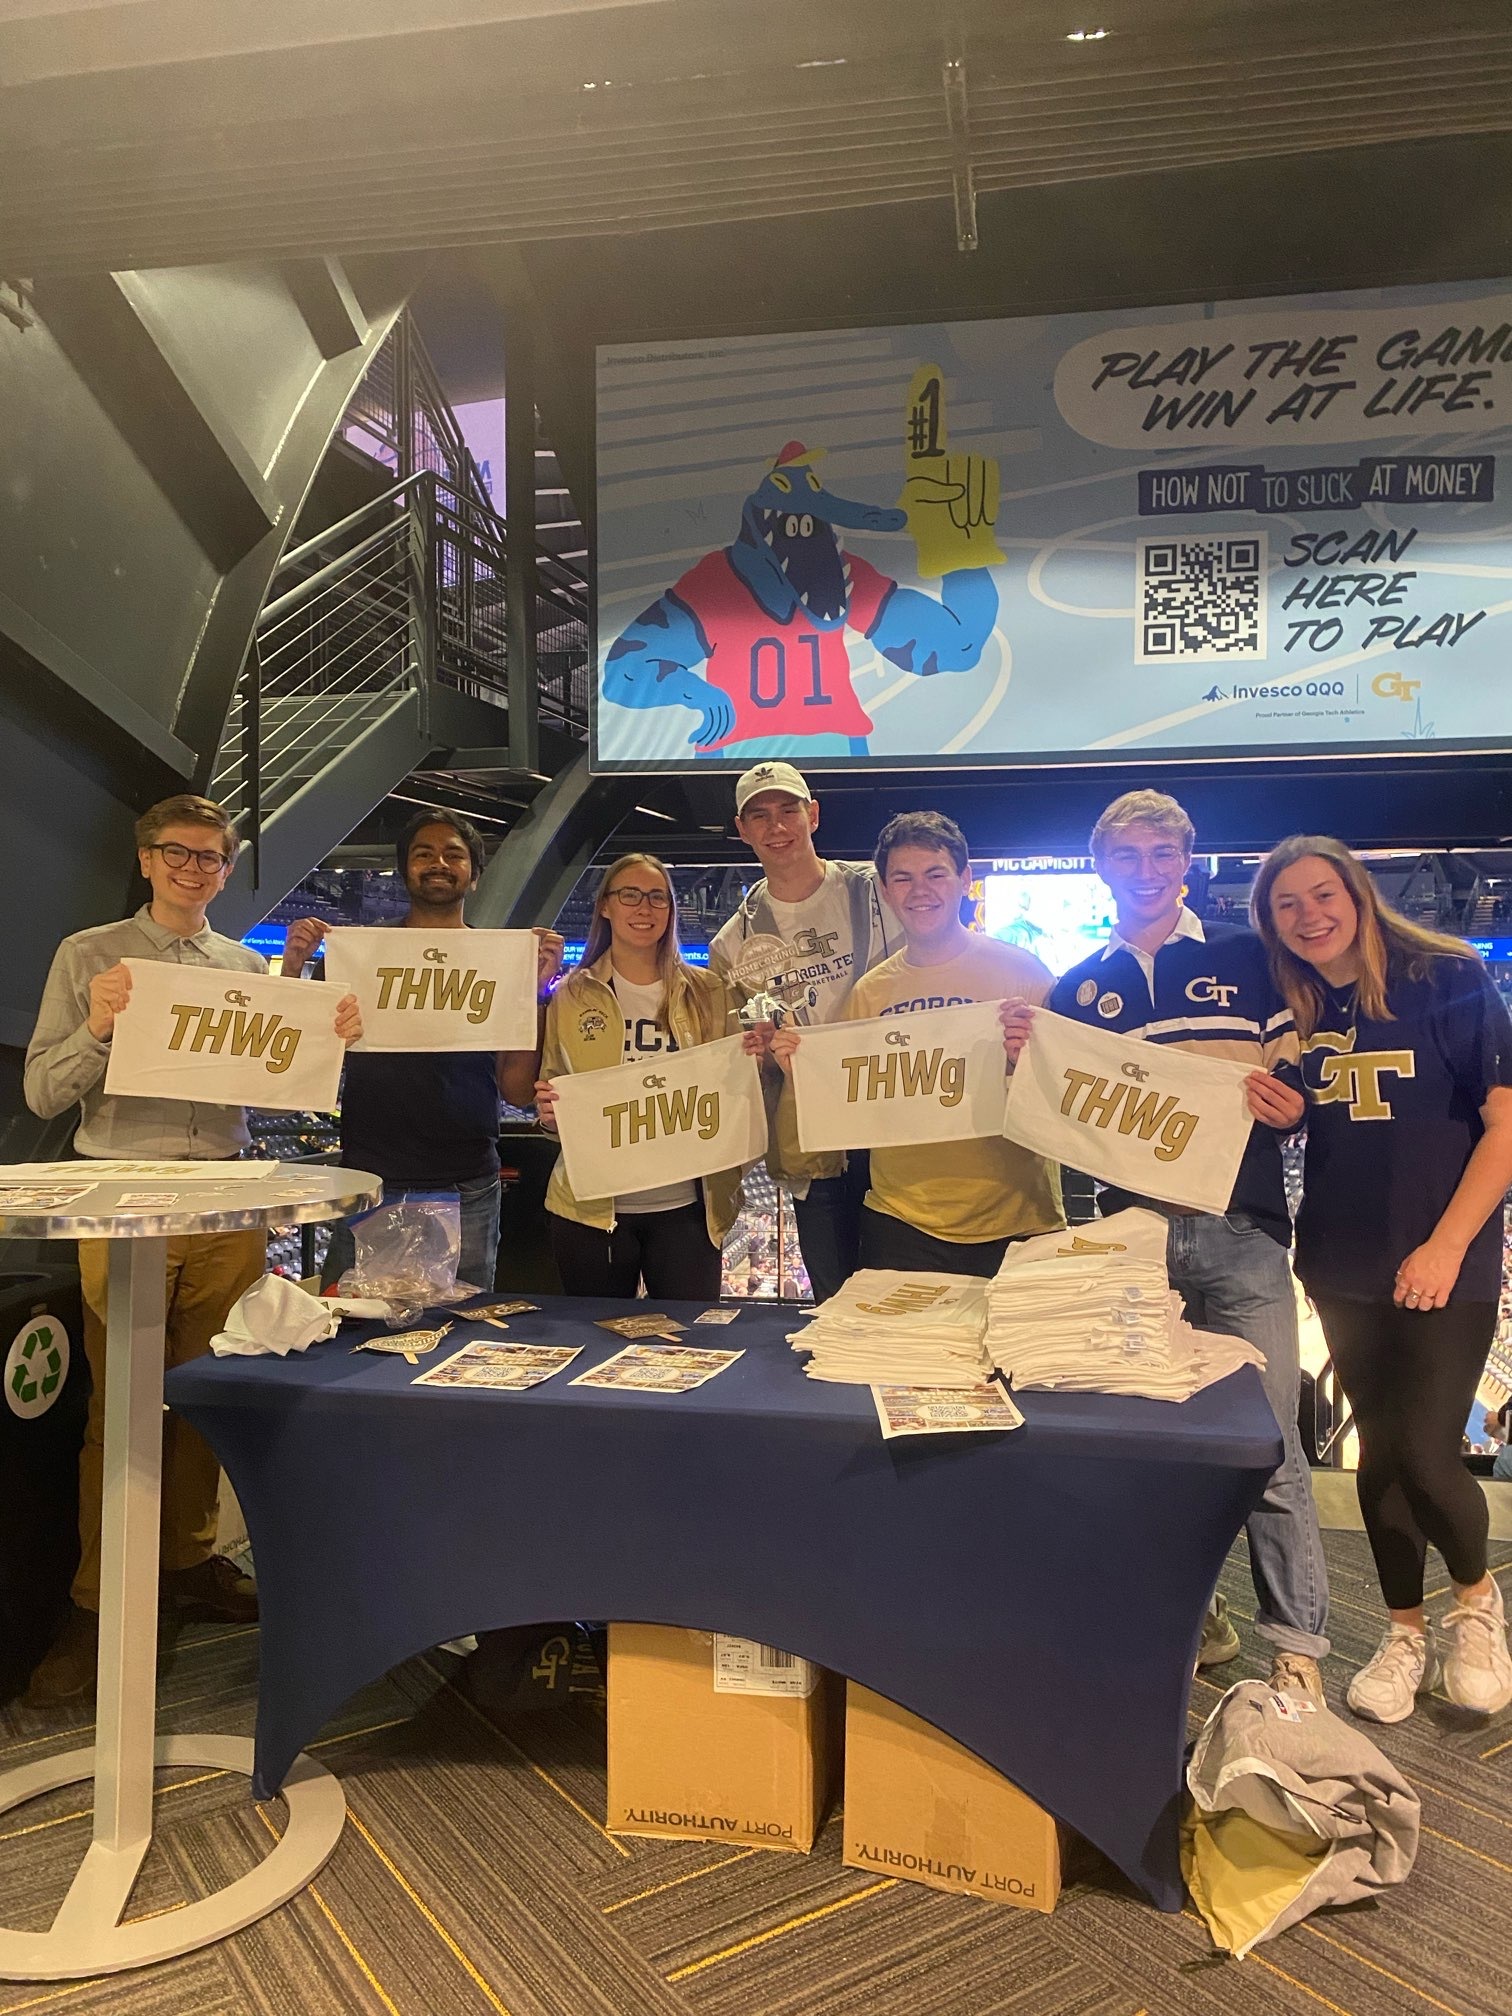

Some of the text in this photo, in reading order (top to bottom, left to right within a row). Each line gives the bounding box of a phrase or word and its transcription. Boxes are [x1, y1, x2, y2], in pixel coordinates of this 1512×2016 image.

[1091, 343, 1235, 392] PLAY
[1243, 335, 1357, 378] THE
[908, 377, 945, 459] #1
[1141, 370, 1494, 432] WIN AT LIFE.
[1152, 462, 1482, 508] HOW NOT TO SUCK AT MONEY
[1283, 527, 1418, 567] SCAN
[1281, 571, 1417, 610] HERE
[1283, 610, 1487, 653] TO PLAY
[750, 634, 832, 709] 01
[1232, 681, 1345, 699] Invesco QQQ
[1371, 671, 1422, 702] GT
[1255, 711, 1272, 719] Proud
[1301, 710, 1324, 718] Georgia
[1339, 708, 1365, 716] Athletics
[731, 947, 795, 978] HOMECOMING
[793, 928, 838, 958] GT
[376, 967, 496, 1025] THWg
[1185, 976, 1238, 1007] GT
[168, 1003, 302, 1075] THWg
[841, 1047, 966, 1107] THWg
[1300, 1027, 1415, 1121] GT
[602, 1085, 720, 1149] THWg
[1059, 1067, 1199, 1163] THWg
[742, 1820, 793, 1839] PORT
[855, 1842, 1036, 1897] PORT AUTHORITY.
